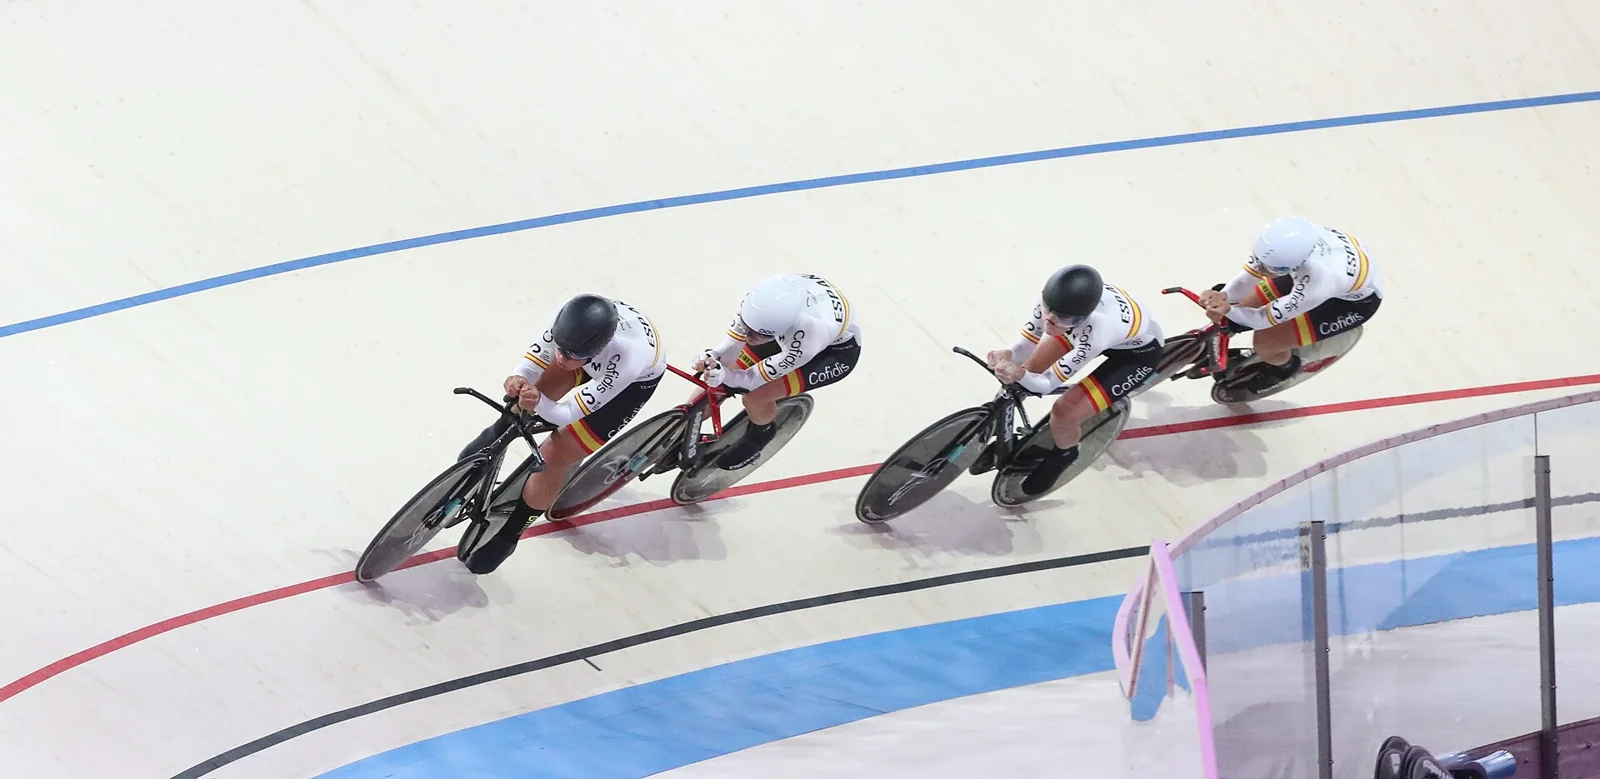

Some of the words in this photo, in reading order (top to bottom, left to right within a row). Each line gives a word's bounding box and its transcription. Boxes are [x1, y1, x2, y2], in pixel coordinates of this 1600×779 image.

[1285, 275, 1310, 313] Cofidis
[1320, 312, 1364, 335] Cofidis
[778, 330, 805, 370] Cofidis
[1072, 325, 1093, 365] Cofidis
[596, 353, 621, 394] Cofidis
[808, 362, 850, 386] Cofidis
[1111, 365, 1153, 397] Cofidis
